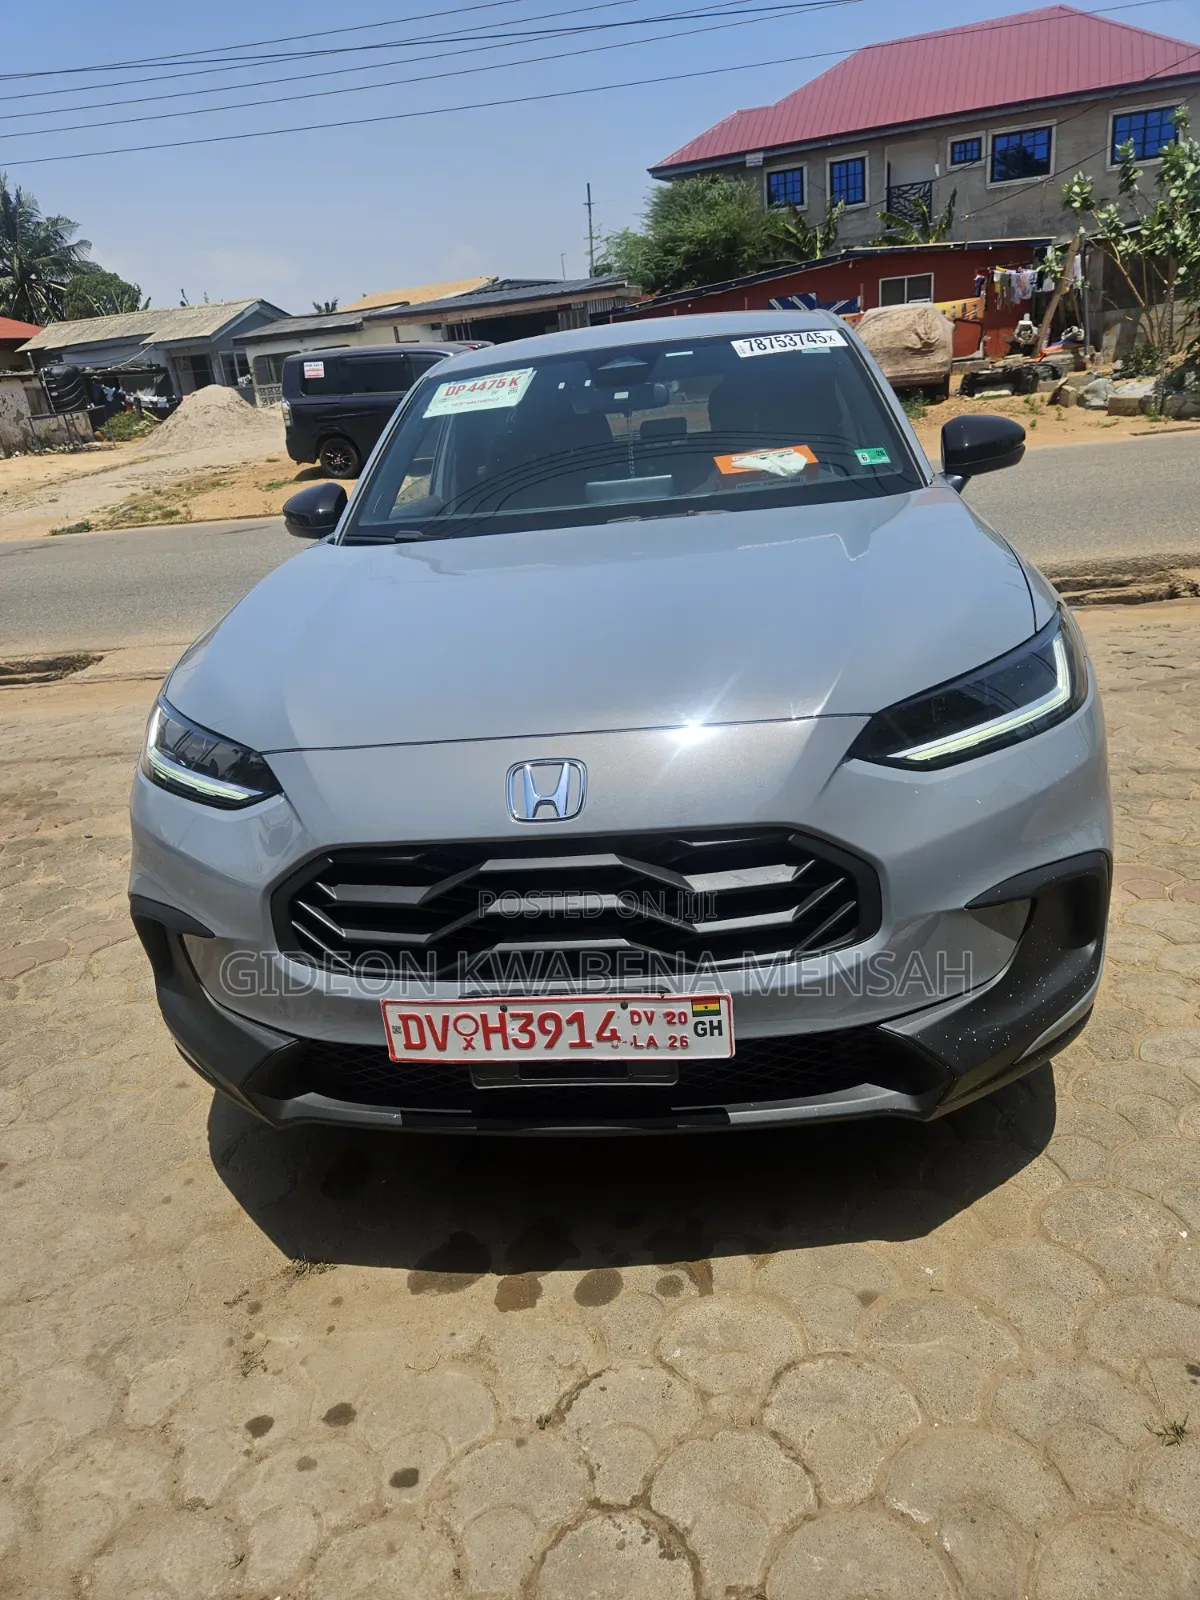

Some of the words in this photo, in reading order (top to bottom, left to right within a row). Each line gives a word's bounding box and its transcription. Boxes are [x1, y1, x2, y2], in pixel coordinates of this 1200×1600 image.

[743, 332, 827, 352] 78753745
[444, 384, 466, 397] DP
[467, 378, 507, 392] 4475
[508, 376, 522, 388] K
[629, 1009, 656, 1026] DV
[663, 1009, 688, 1026] 20
[693, 1019, 724, 1038] GH
[632, 1034, 659, 1050] LA
[667, 1034, 690, 1050] 26
